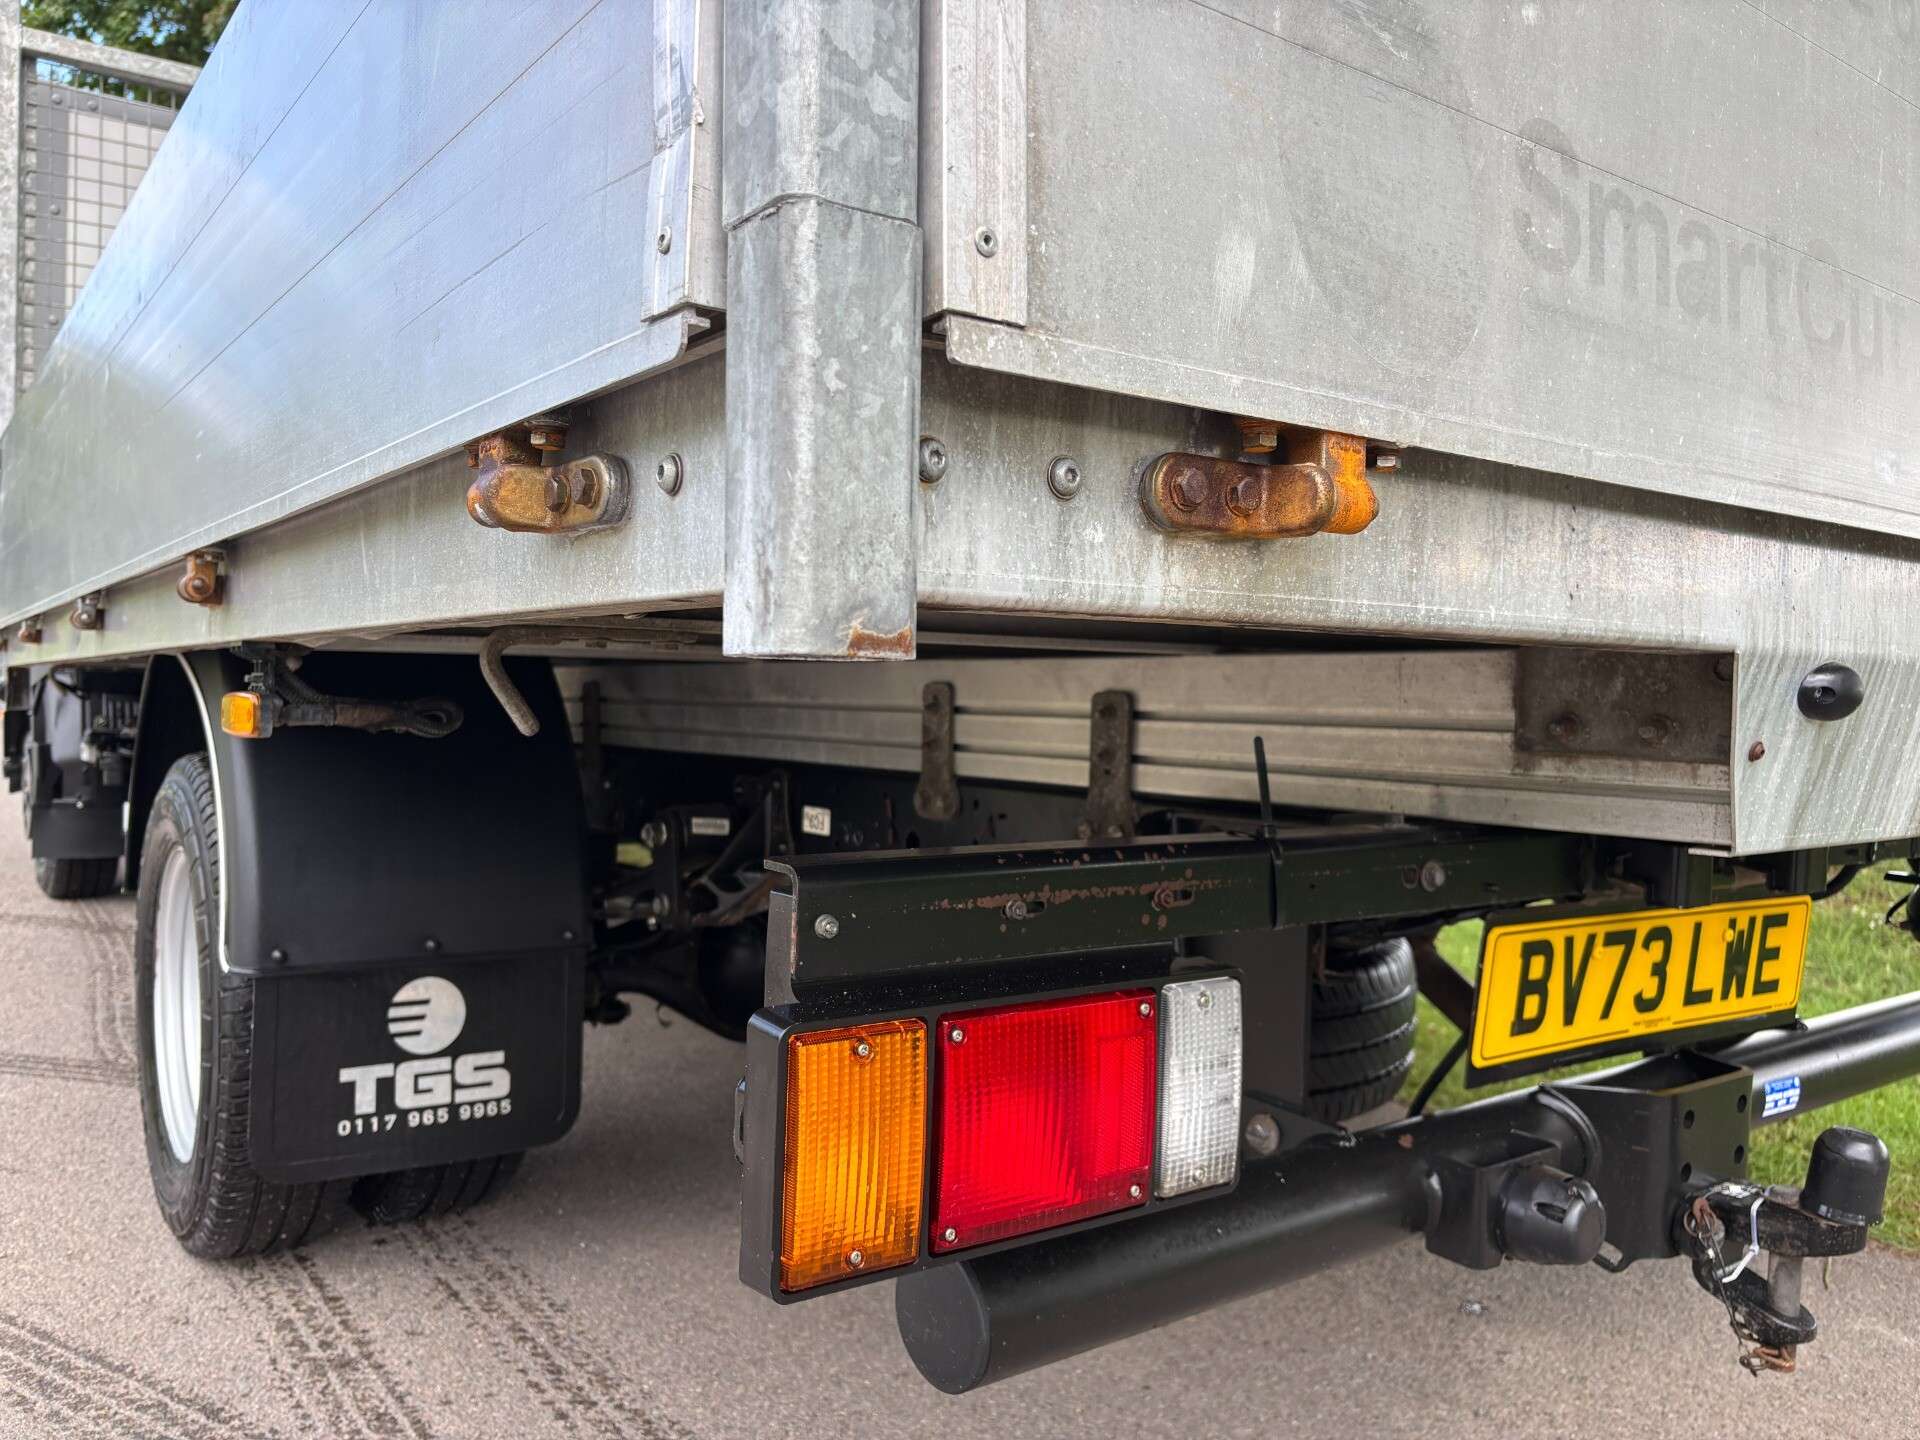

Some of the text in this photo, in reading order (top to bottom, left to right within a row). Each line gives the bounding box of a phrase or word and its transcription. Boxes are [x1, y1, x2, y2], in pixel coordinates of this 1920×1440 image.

[1509, 913, 1789, 1037] BV73 LWE
[339, 1050, 511, 1115] TGS
[337, 1098, 512, 1137] 0117 965 9965
